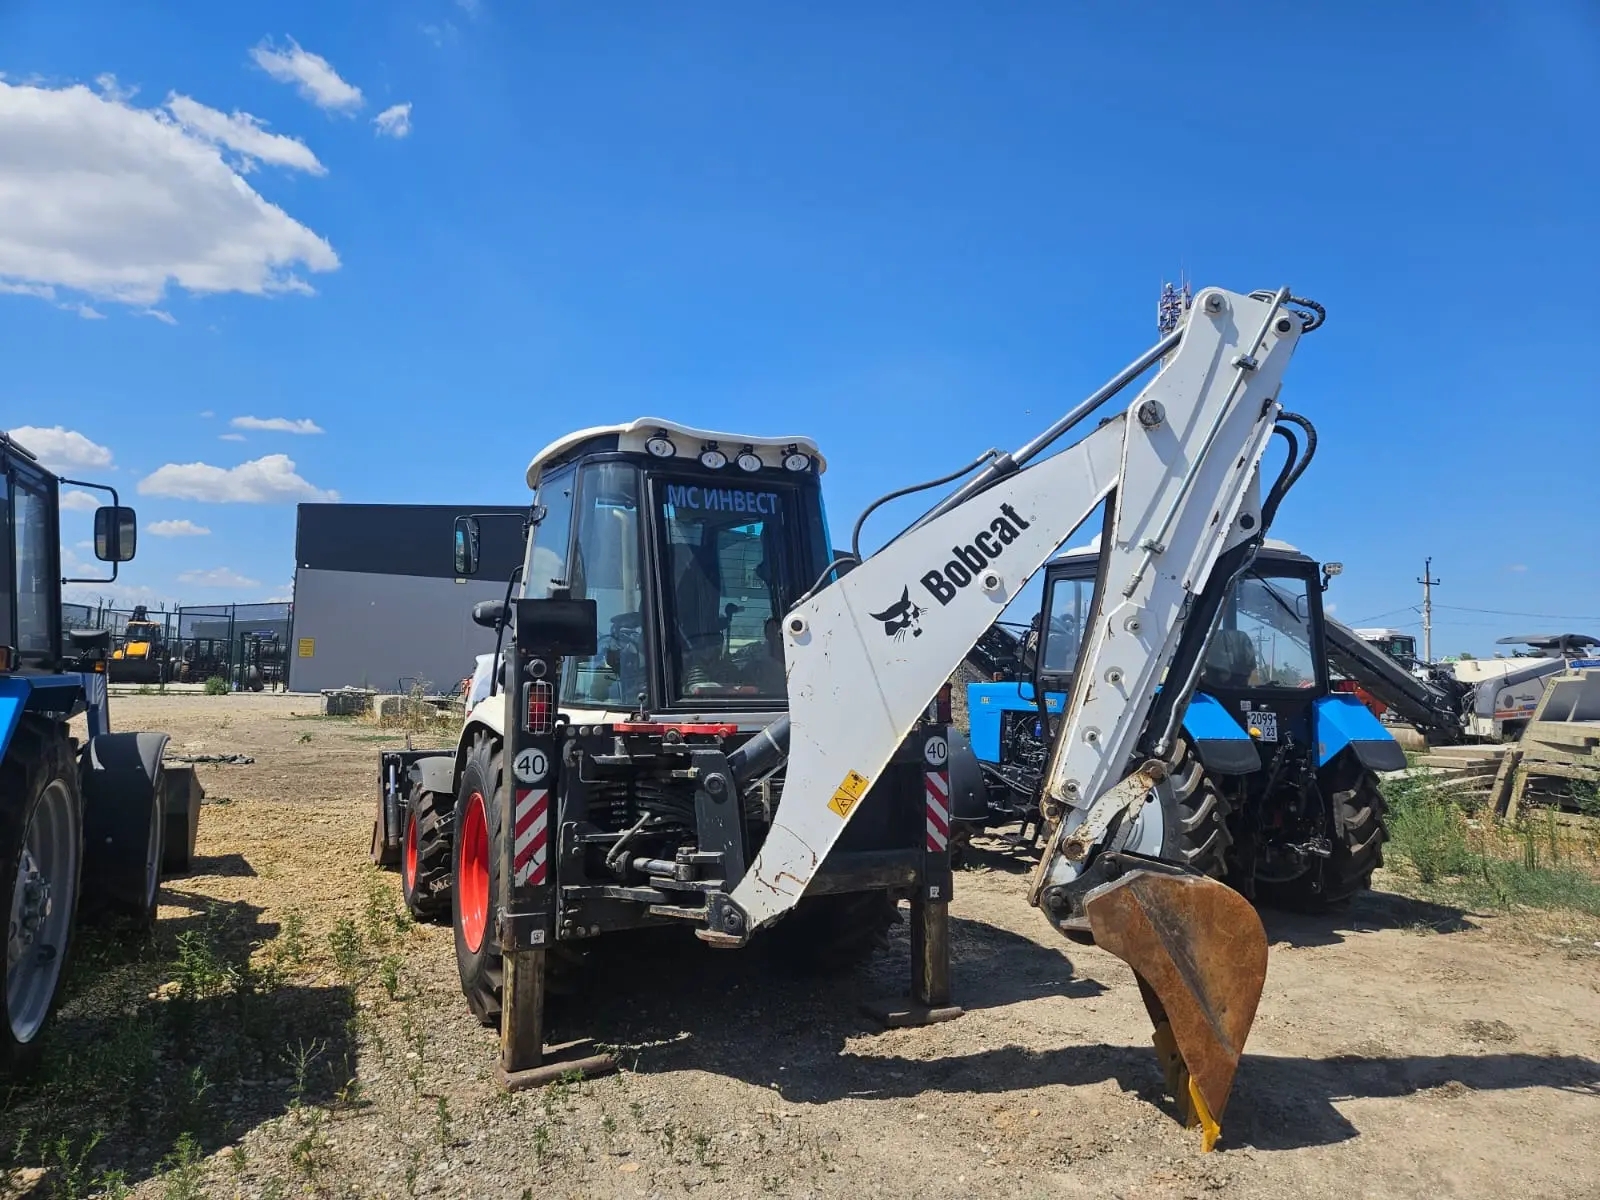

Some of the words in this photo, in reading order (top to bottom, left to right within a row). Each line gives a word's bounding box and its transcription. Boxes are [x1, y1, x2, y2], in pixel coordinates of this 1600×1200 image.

[667, 484, 699, 509] МС
[703, 488, 777, 514] ИНВЕСТ
[920, 502, 1030, 606] Bobcat
[1250, 712, 1273, 726] 2099
[1266, 727, 1275, 737] 23
[927, 742, 946, 759] 40
[518, 755, 545, 775] 40
